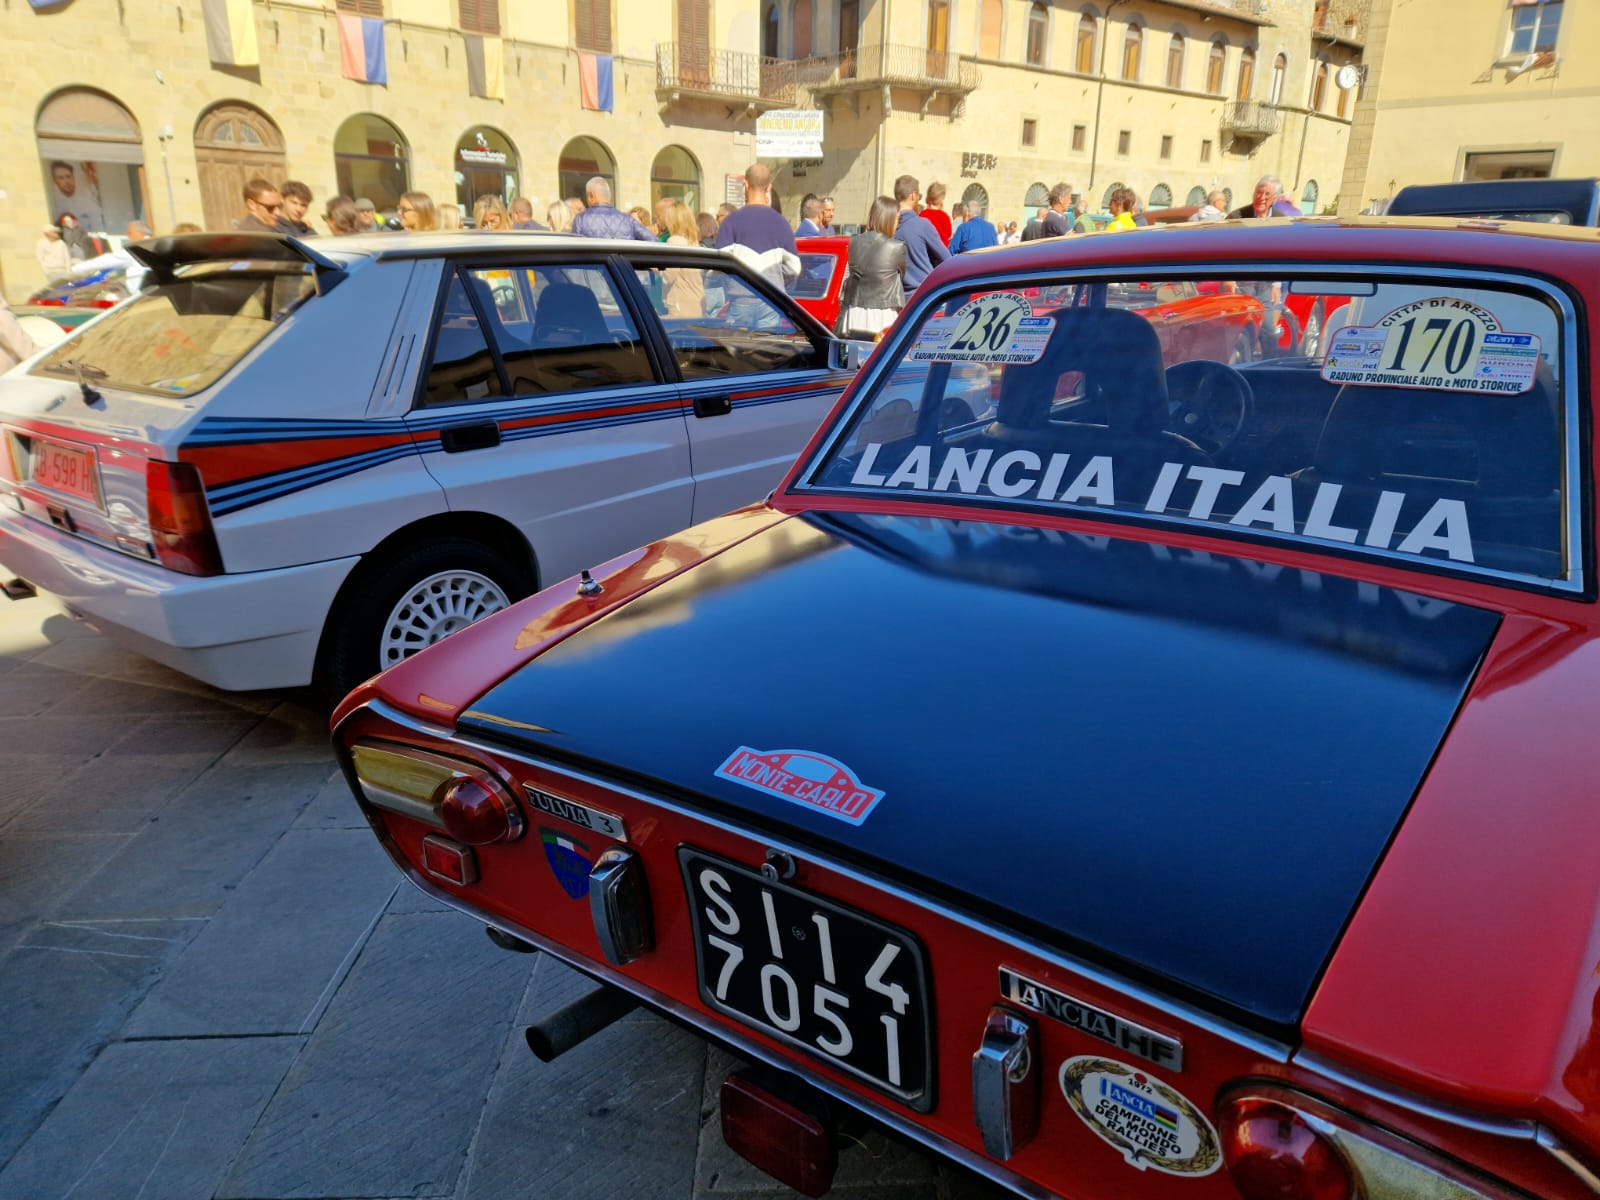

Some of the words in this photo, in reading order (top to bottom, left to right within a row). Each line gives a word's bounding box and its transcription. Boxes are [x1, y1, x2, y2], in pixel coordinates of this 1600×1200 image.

[957, 295, 989, 317] CITTA'
[1003, 293, 1031, 316] AREZZO
[1381, 302, 1425, 328] CITTA'
[1429, 300, 1446, 308] DI
[1450, 300, 1498, 332] AREZZO
[950, 305, 1024, 352] 236
[1385, 317, 1476, 375] 170
[1485, 334, 1516, 344] atam
[914, 352, 937, 360] RADUNO
[936, 352, 970, 361] PROVINCIALE
[970, 353, 986, 361] AUTO
[990, 354, 1007, 362] MOTO
[1007, 353, 1036, 362] STORICHE
[1330, 371, 1364, 382] RADUNO
[1365, 373, 1418, 386] PROVINCIALE
[1419, 376, 1443, 388] AUTO
[1453, 377, 1479, 390] MOTO
[1479, 378, 1523, 392] STORICHE
[53, 452, 77, 487] 598
[851, 443, 1115, 506] LANCIA
[1144, 462, 1475, 563] ITALIA
[729, 753, 867, 815] MONTE-CARLO
[525, 789, 592, 827] FULVIA
[598, 815, 614, 834] 3
[707, 934, 901, 1086] 7051
[1008, 973, 1116, 1042] LANCIA
[1120, 1026, 1175, 1063] HF
[1104, 1079, 1155, 1117] LANCIA
[1127, 1077, 1153, 1095] 1972
[1095, 1104, 1121, 1125] DEL
[1126, 1119, 1182, 1154] MONDO
[1099, 1098, 1178, 1144] CAMPIONE
[1106, 1119, 1167, 1157] RALLIES
